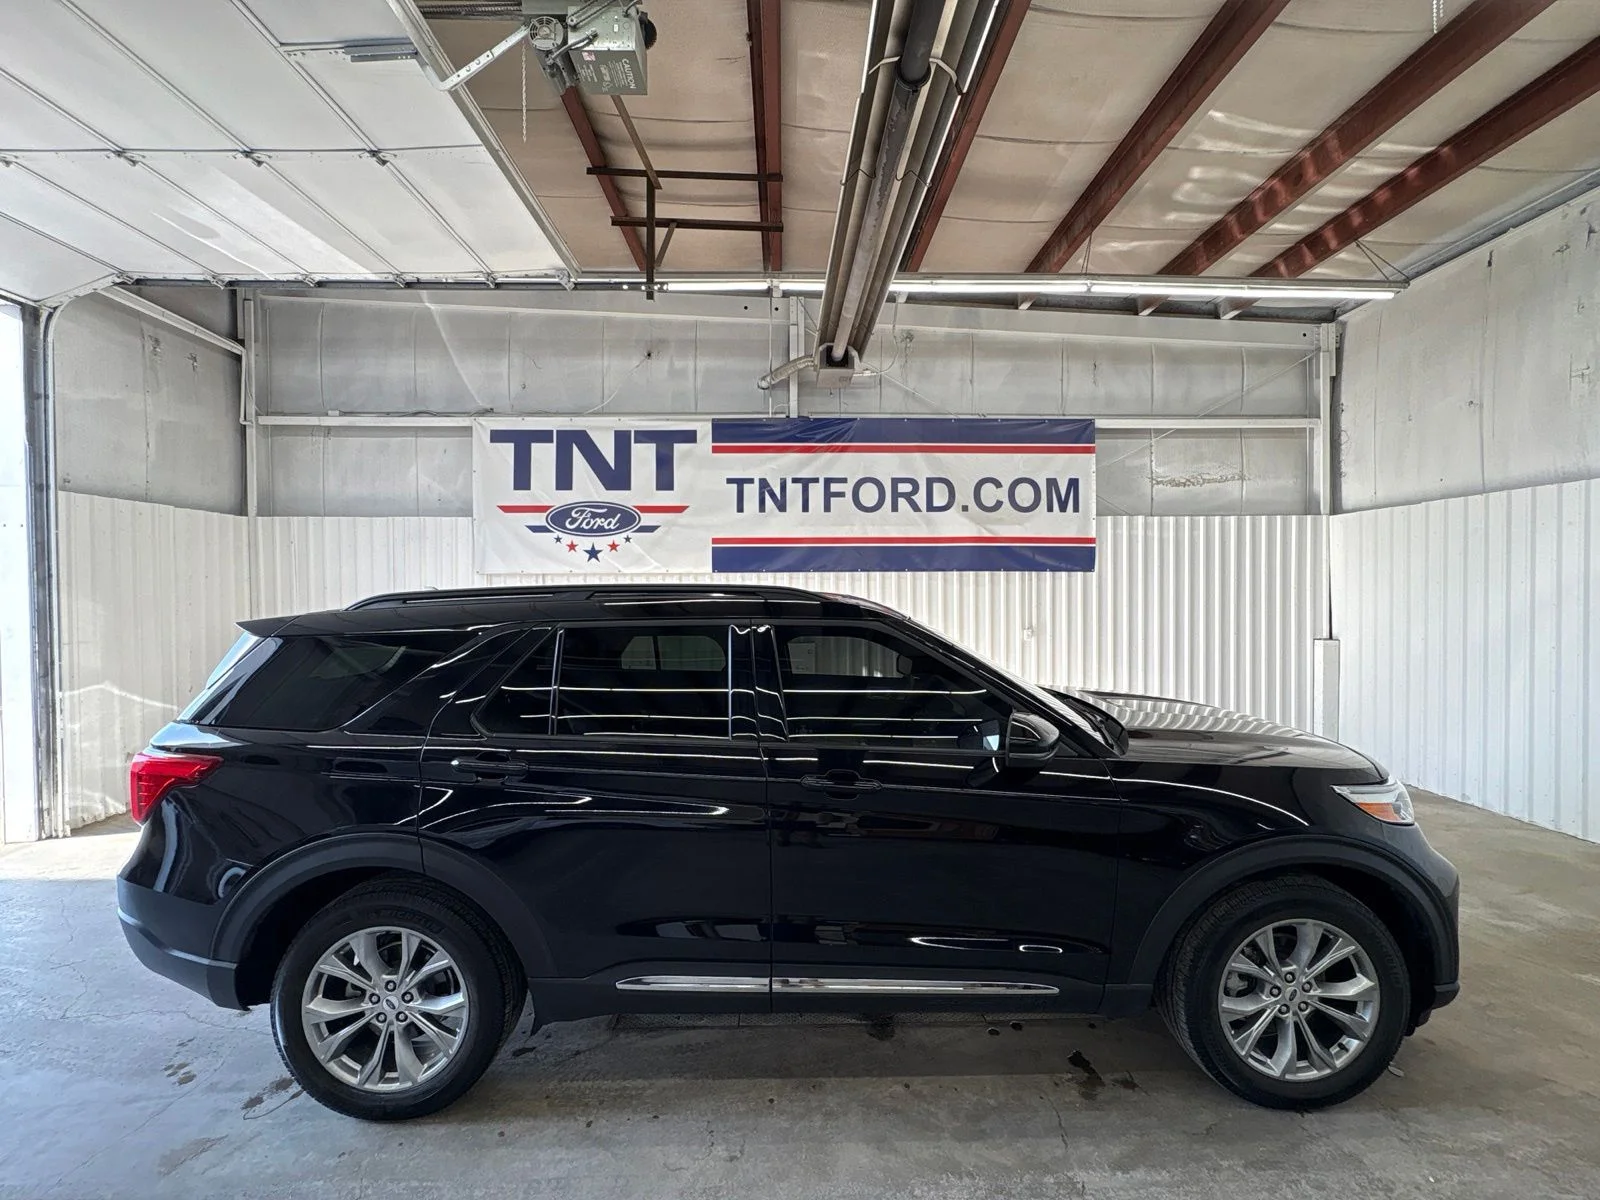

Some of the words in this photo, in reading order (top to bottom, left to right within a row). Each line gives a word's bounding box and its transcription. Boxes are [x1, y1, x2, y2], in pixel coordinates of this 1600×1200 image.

[622, 58, 637, 89] CAUTION
[490, 429, 697, 491] TNT
[726, 477, 1080, 513] TNTFORD.COM
[565, 507, 621, 530] Ford
